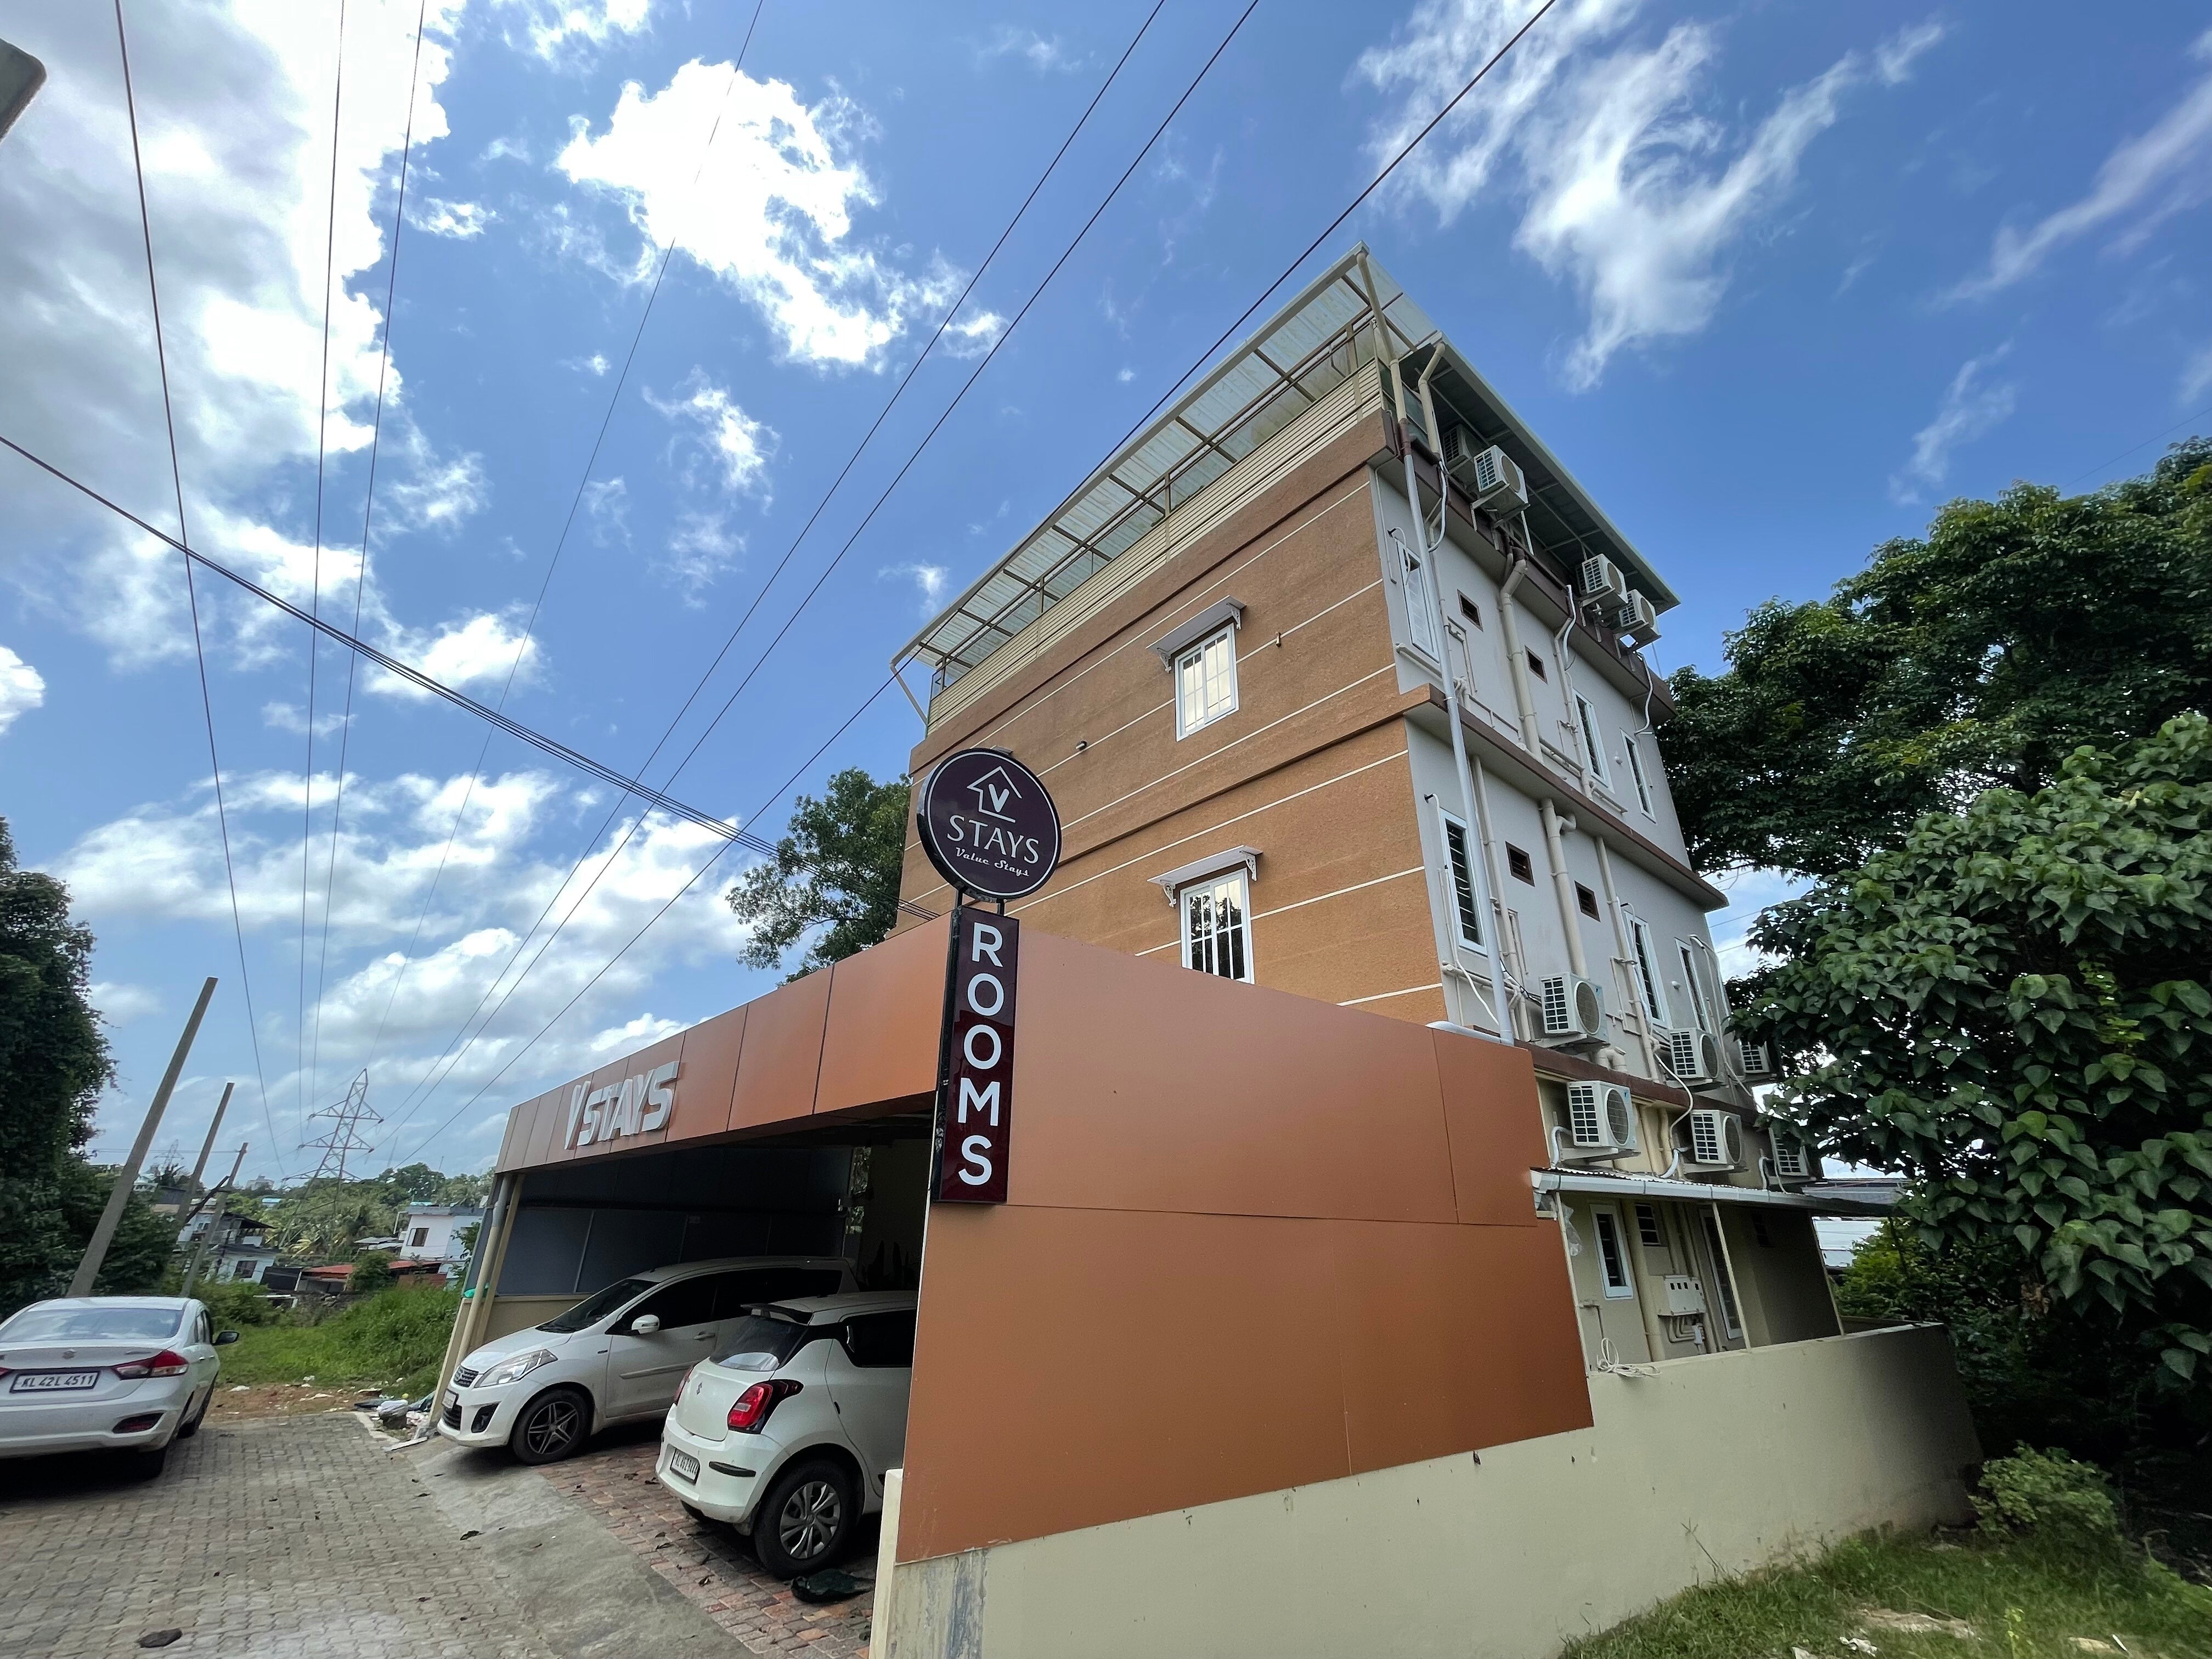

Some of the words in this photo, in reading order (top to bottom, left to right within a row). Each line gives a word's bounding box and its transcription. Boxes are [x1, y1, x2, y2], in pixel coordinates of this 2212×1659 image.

[989, 783, 1010, 812] V
[947, 815, 1039, 864] STAYS
[955, 847, 990, 865] Value
[994, 860, 1029, 877] Stays
[958, 922, 1005, 1187] ROOMS
[21, 1376, 36, 1387] KL
[64, 1375, 93, 1386] 4511
